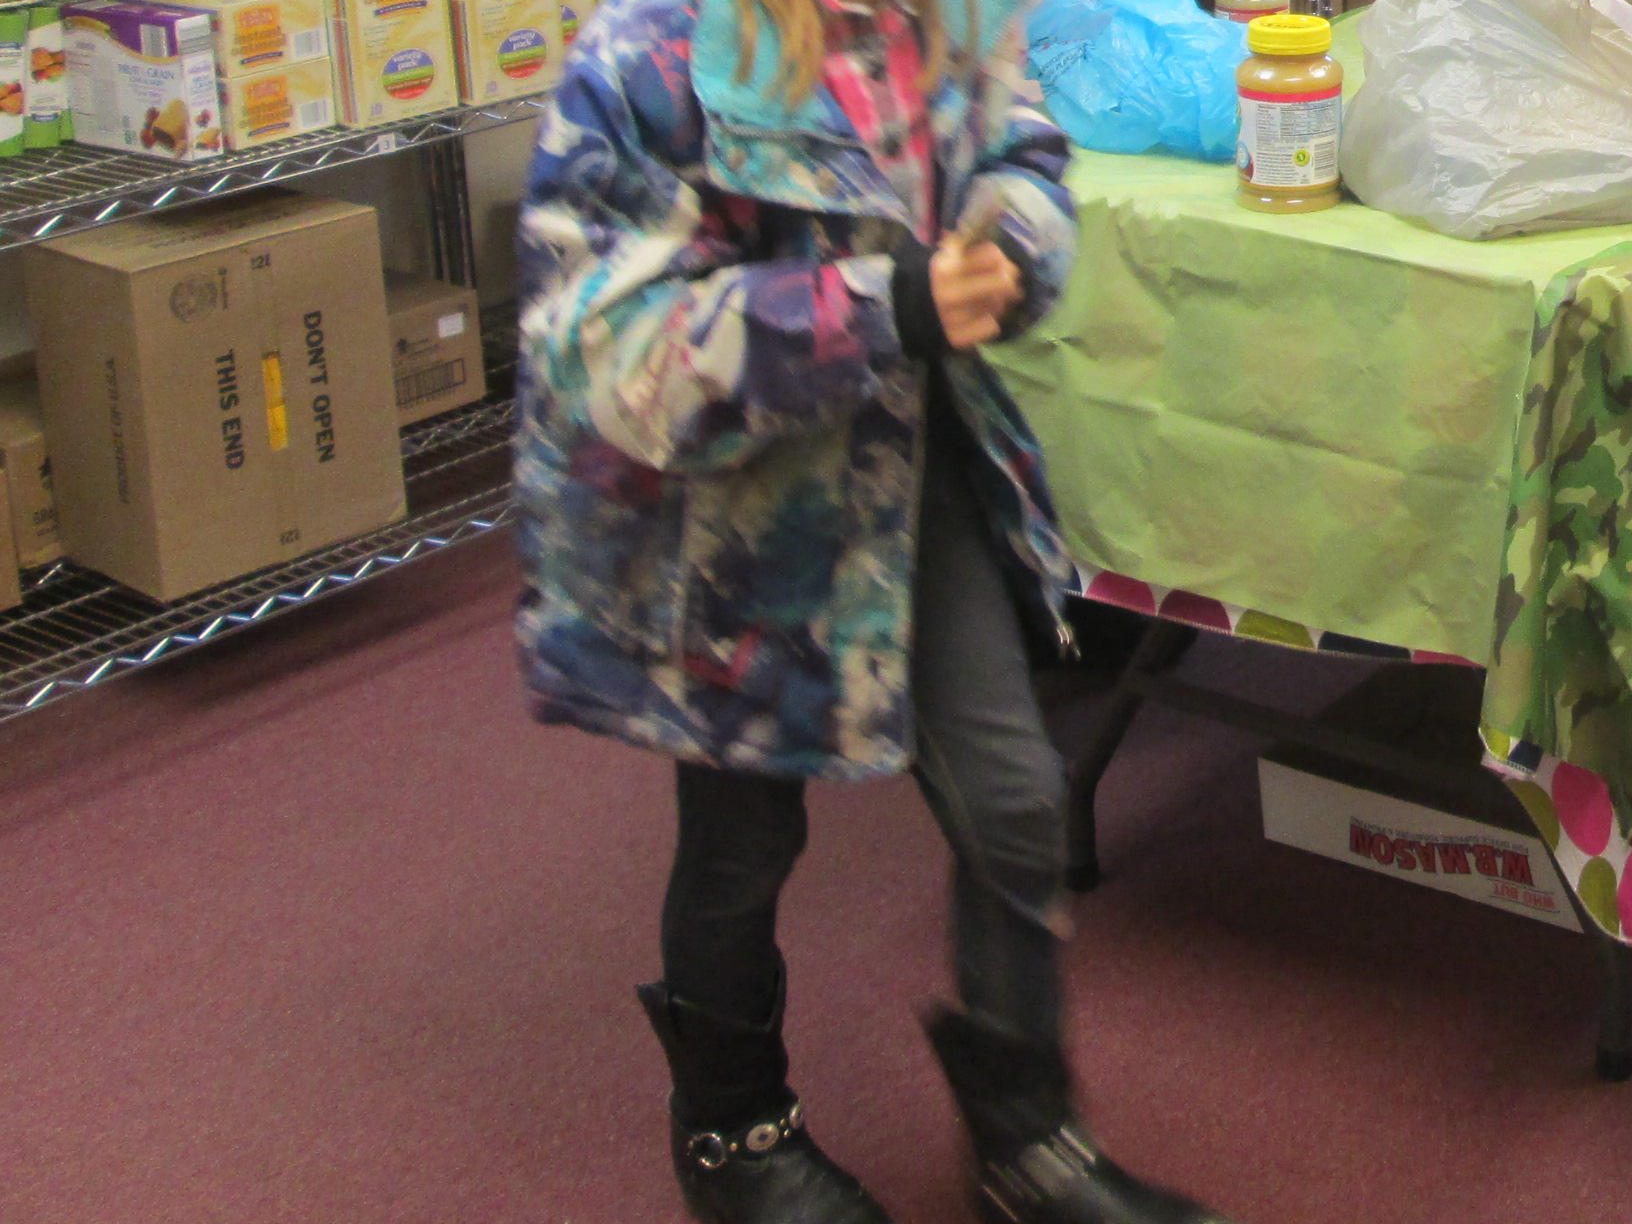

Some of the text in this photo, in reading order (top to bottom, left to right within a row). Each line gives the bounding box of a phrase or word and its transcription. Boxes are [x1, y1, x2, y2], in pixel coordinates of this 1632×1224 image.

[397, 59, 418, 71] pack
[513, 40, 532, 52] pack
[303, 309, 328, 386] DON'T
[215, 348, 240, 412] THIS
[222, 416, 246, 470] END
[311, 394, 336, 463] OPEN
[1493, 883, 1557, 910] WHO BUT
